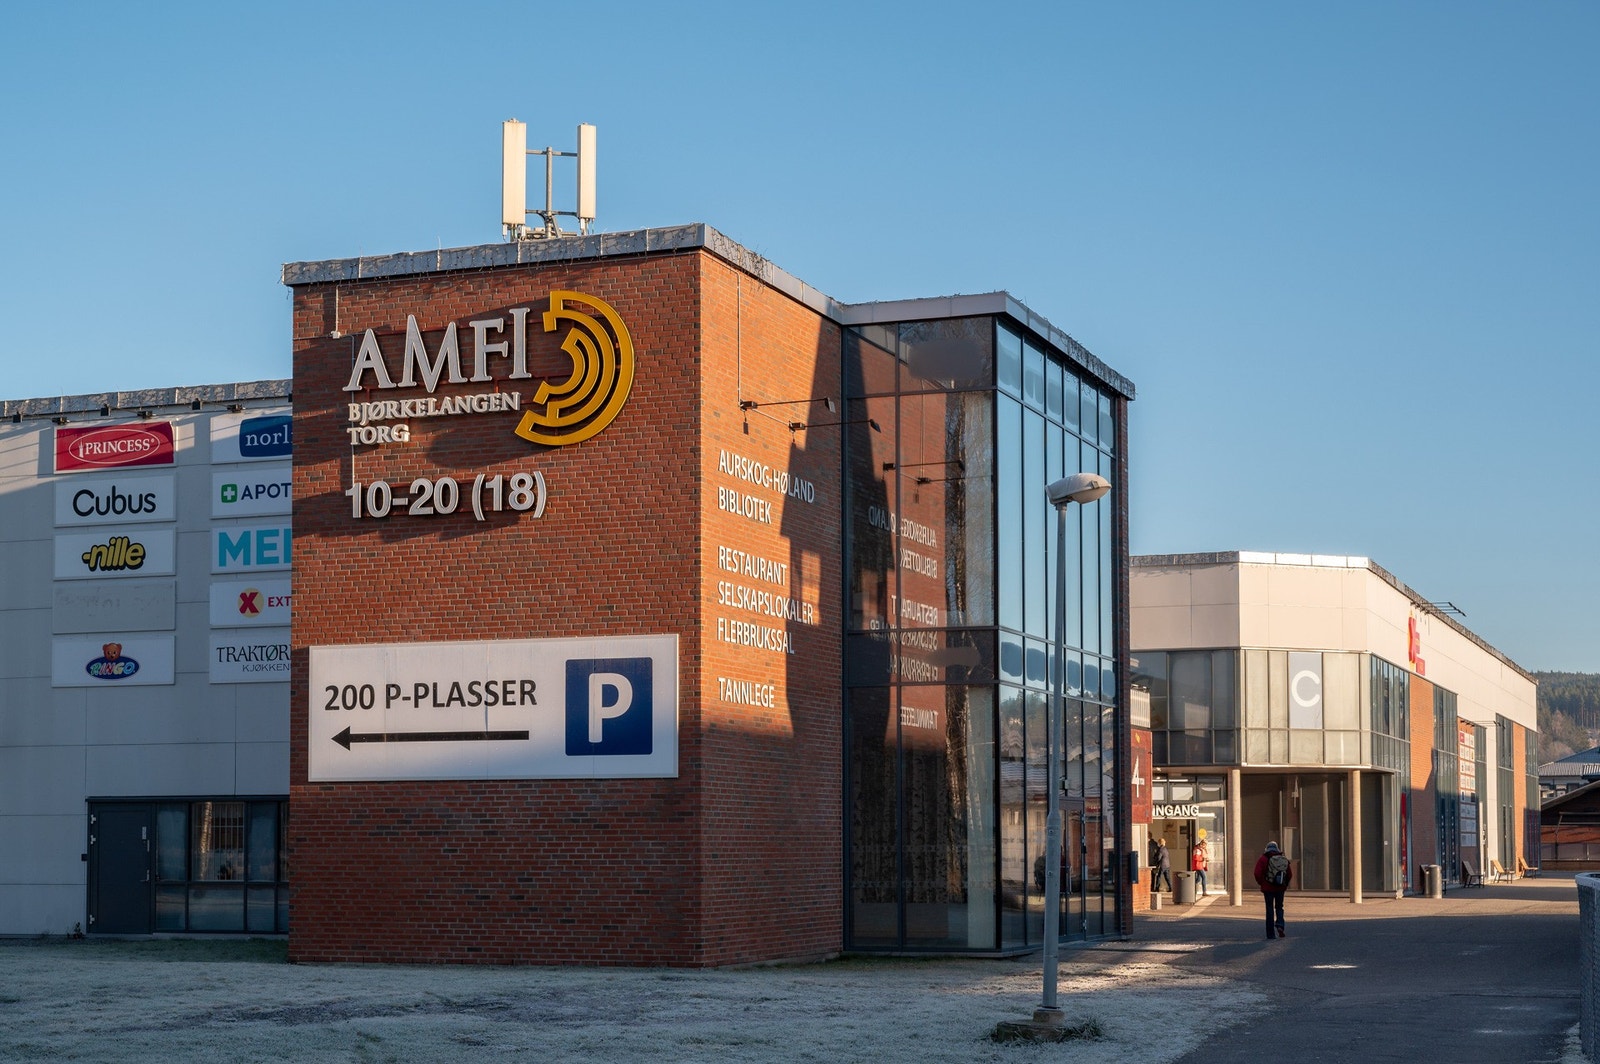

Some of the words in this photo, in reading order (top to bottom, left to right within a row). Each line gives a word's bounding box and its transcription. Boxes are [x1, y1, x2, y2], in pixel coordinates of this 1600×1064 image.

[342, 307, 532, 393] AMFI
[348, 391, 521, 426] BJØRKELANGEN
[84, 438, 151, 455] PRINCESS
[245, 424, 293, 447] norl
[347, 424, 411, 446] TORG
[718, 449, 815, 504] AURSKOG-HØLAND
[72, 485, 157, 517] Cubus
[345, 477, 460, 519] 10-20
[471, 471, 548, 521] (18)
[718, 486, 772, 525] BIBLIOTEK
[718, 545, 788, 586] RESTAURANT
[718, 581, 814, 626] SELSKAPSLOKALER
[216, 644, 291, 662] TRAKTØR
[718, 617, 795, 654] FLERBRUKSSAL
[89, 661, 135, 676] RINGO
[324, 683, 376, 711] 200
[385, 679, 538, 710] P-PLASSER
[588, 672, 634, 743] P
[718, 677, 775, 708] TANNLEGE
[1291, 670, 1321, 708] C
[1131, 755, 1145, 798] 4
